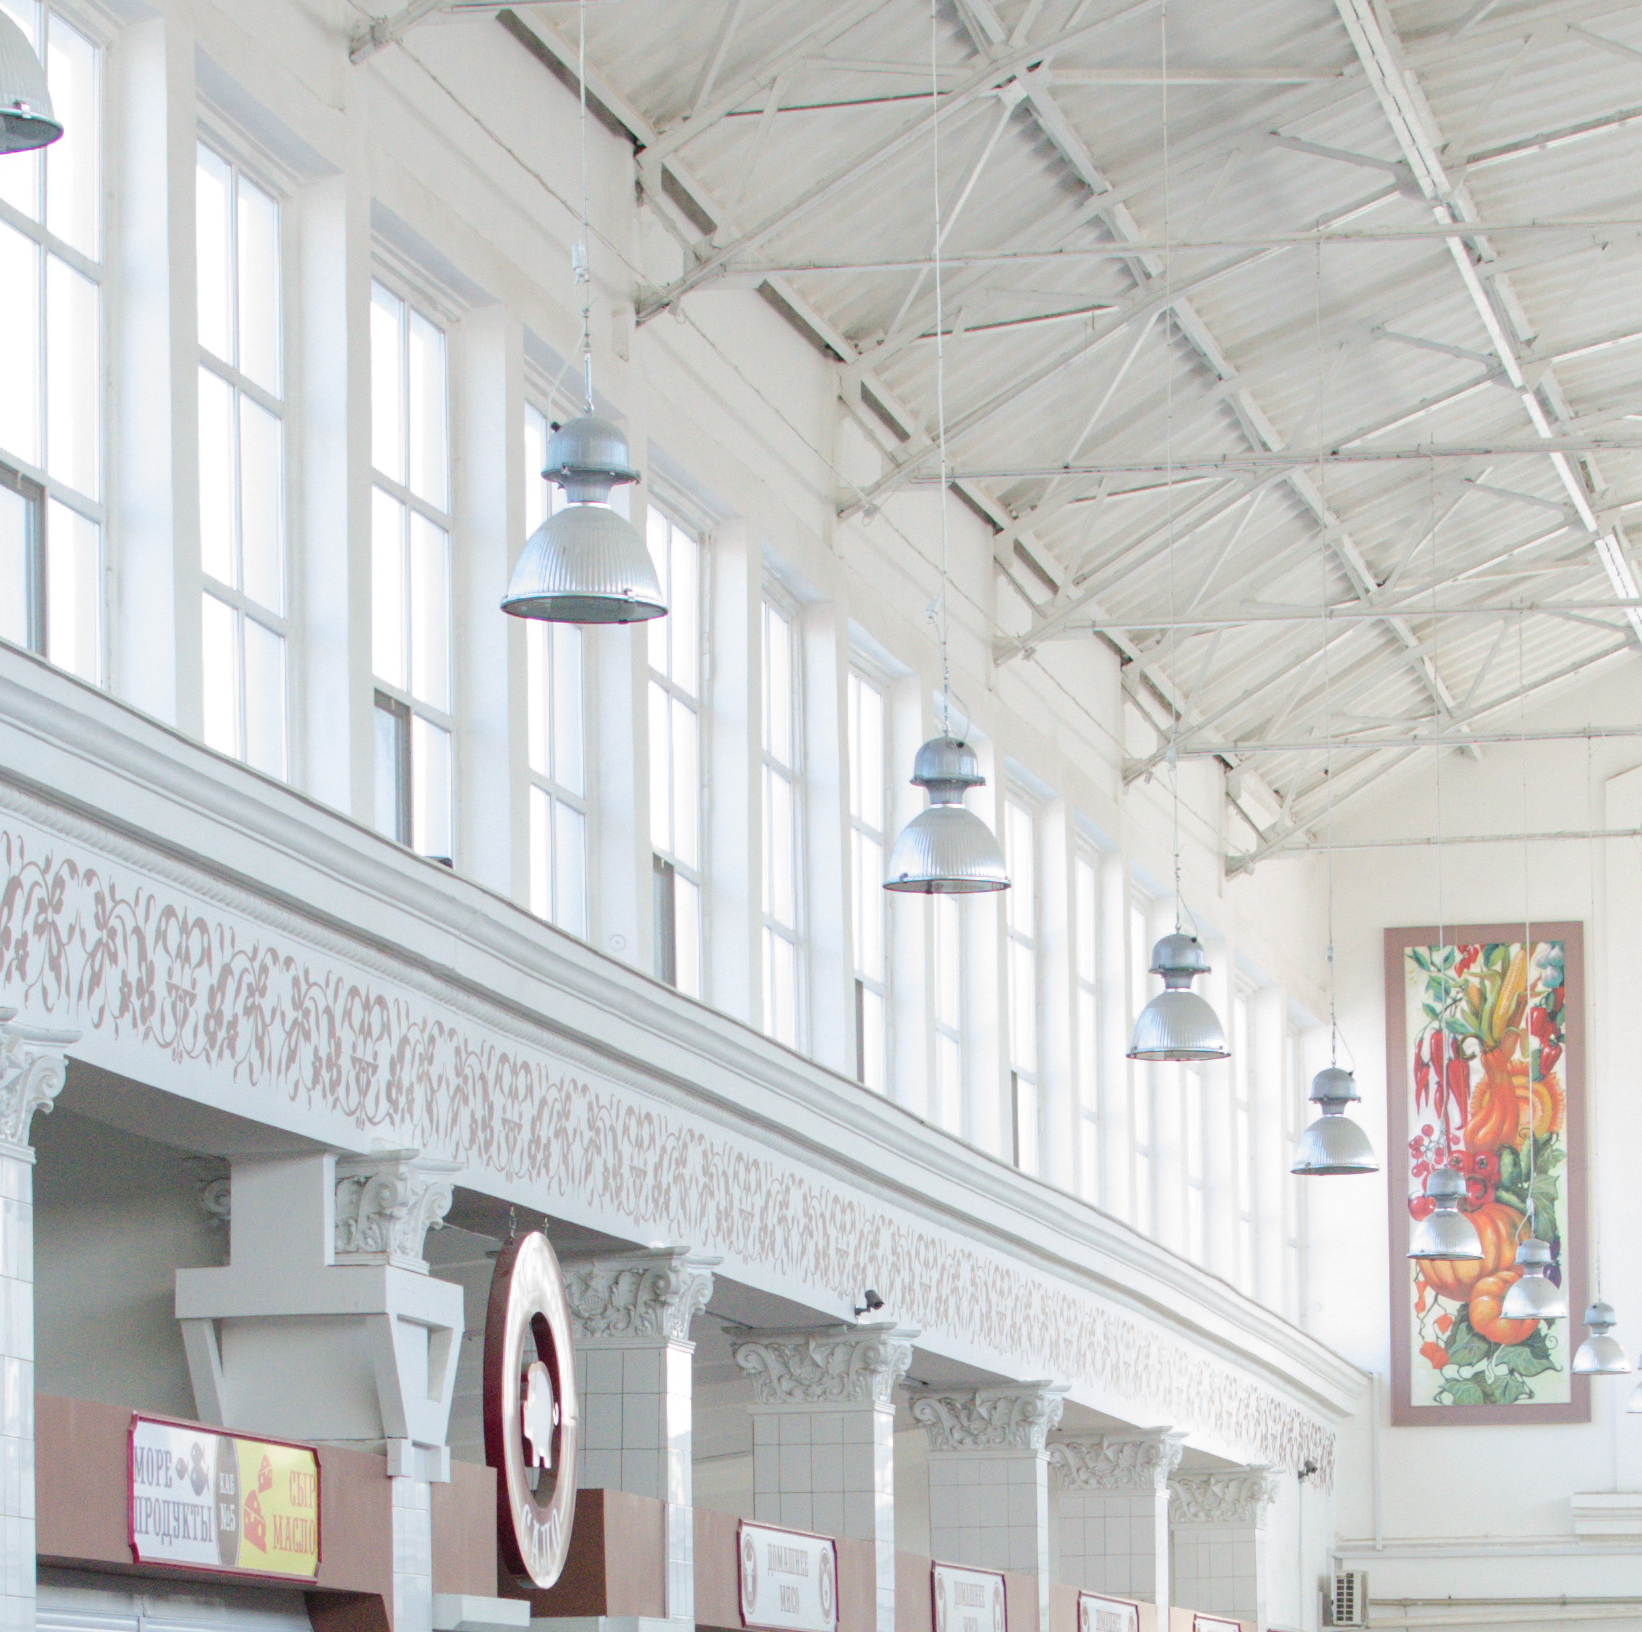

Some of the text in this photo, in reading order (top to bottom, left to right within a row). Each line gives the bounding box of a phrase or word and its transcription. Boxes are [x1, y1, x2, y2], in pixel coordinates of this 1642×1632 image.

[134, 1445, 172, 1489] МОРЕ
[290, 1469, 316, 1509] СЫР
[134, 1495, 213, 1547] ПРОДУКТЫ
[273, 1513, 315, 1556] МАСЛО
[521, 1503, 562, 1574] САЛО
